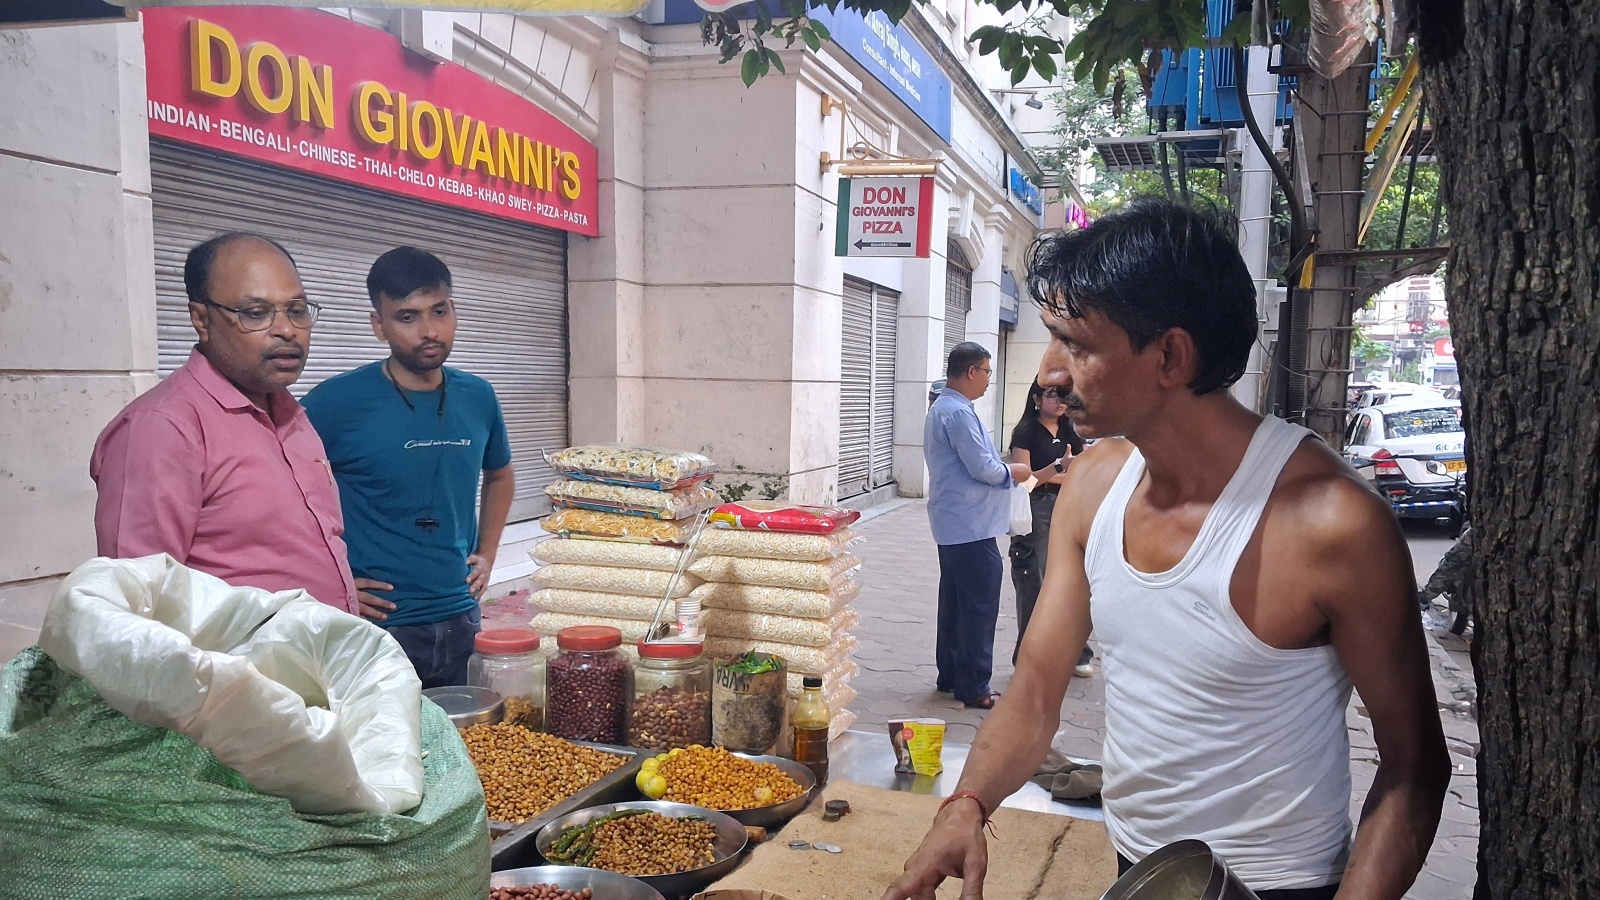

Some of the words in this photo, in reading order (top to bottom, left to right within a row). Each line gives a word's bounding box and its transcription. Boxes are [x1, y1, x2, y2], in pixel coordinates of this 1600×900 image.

[190, 19, 334, 129] DON
[354, 81, 581, 200] GIOVANNI'S
[863, 187, 906, 204] DON
[852, 206, 915, 217] GIOVANNI'S
[862, 221, 904, 234] PIZZA
